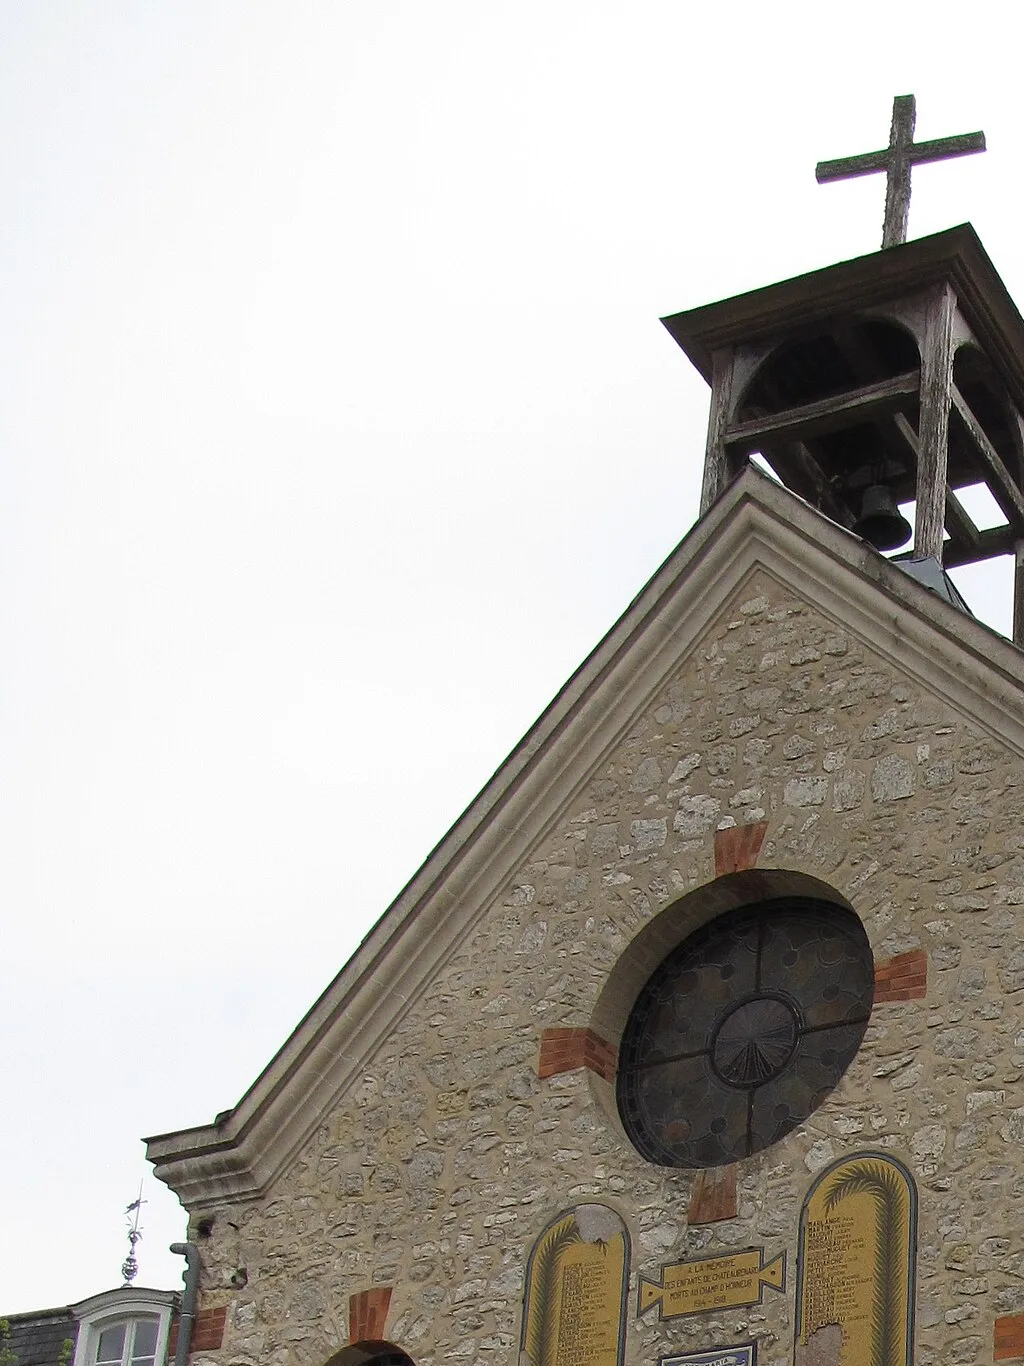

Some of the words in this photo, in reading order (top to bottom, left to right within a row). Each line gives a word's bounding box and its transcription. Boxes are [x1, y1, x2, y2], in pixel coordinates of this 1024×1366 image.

[695, 1265, 704, 1273] LA
[664, 1281, 676, 1290] DES
[676, 1277, 701, 1288] ENFANTS
[703, 1275, 711, 1283] DE
[669, 1289, 689, 1299] MORTS
[691, 1288, 698, 1296] AU
[698, 1286, 719, 1296] CHAMP
